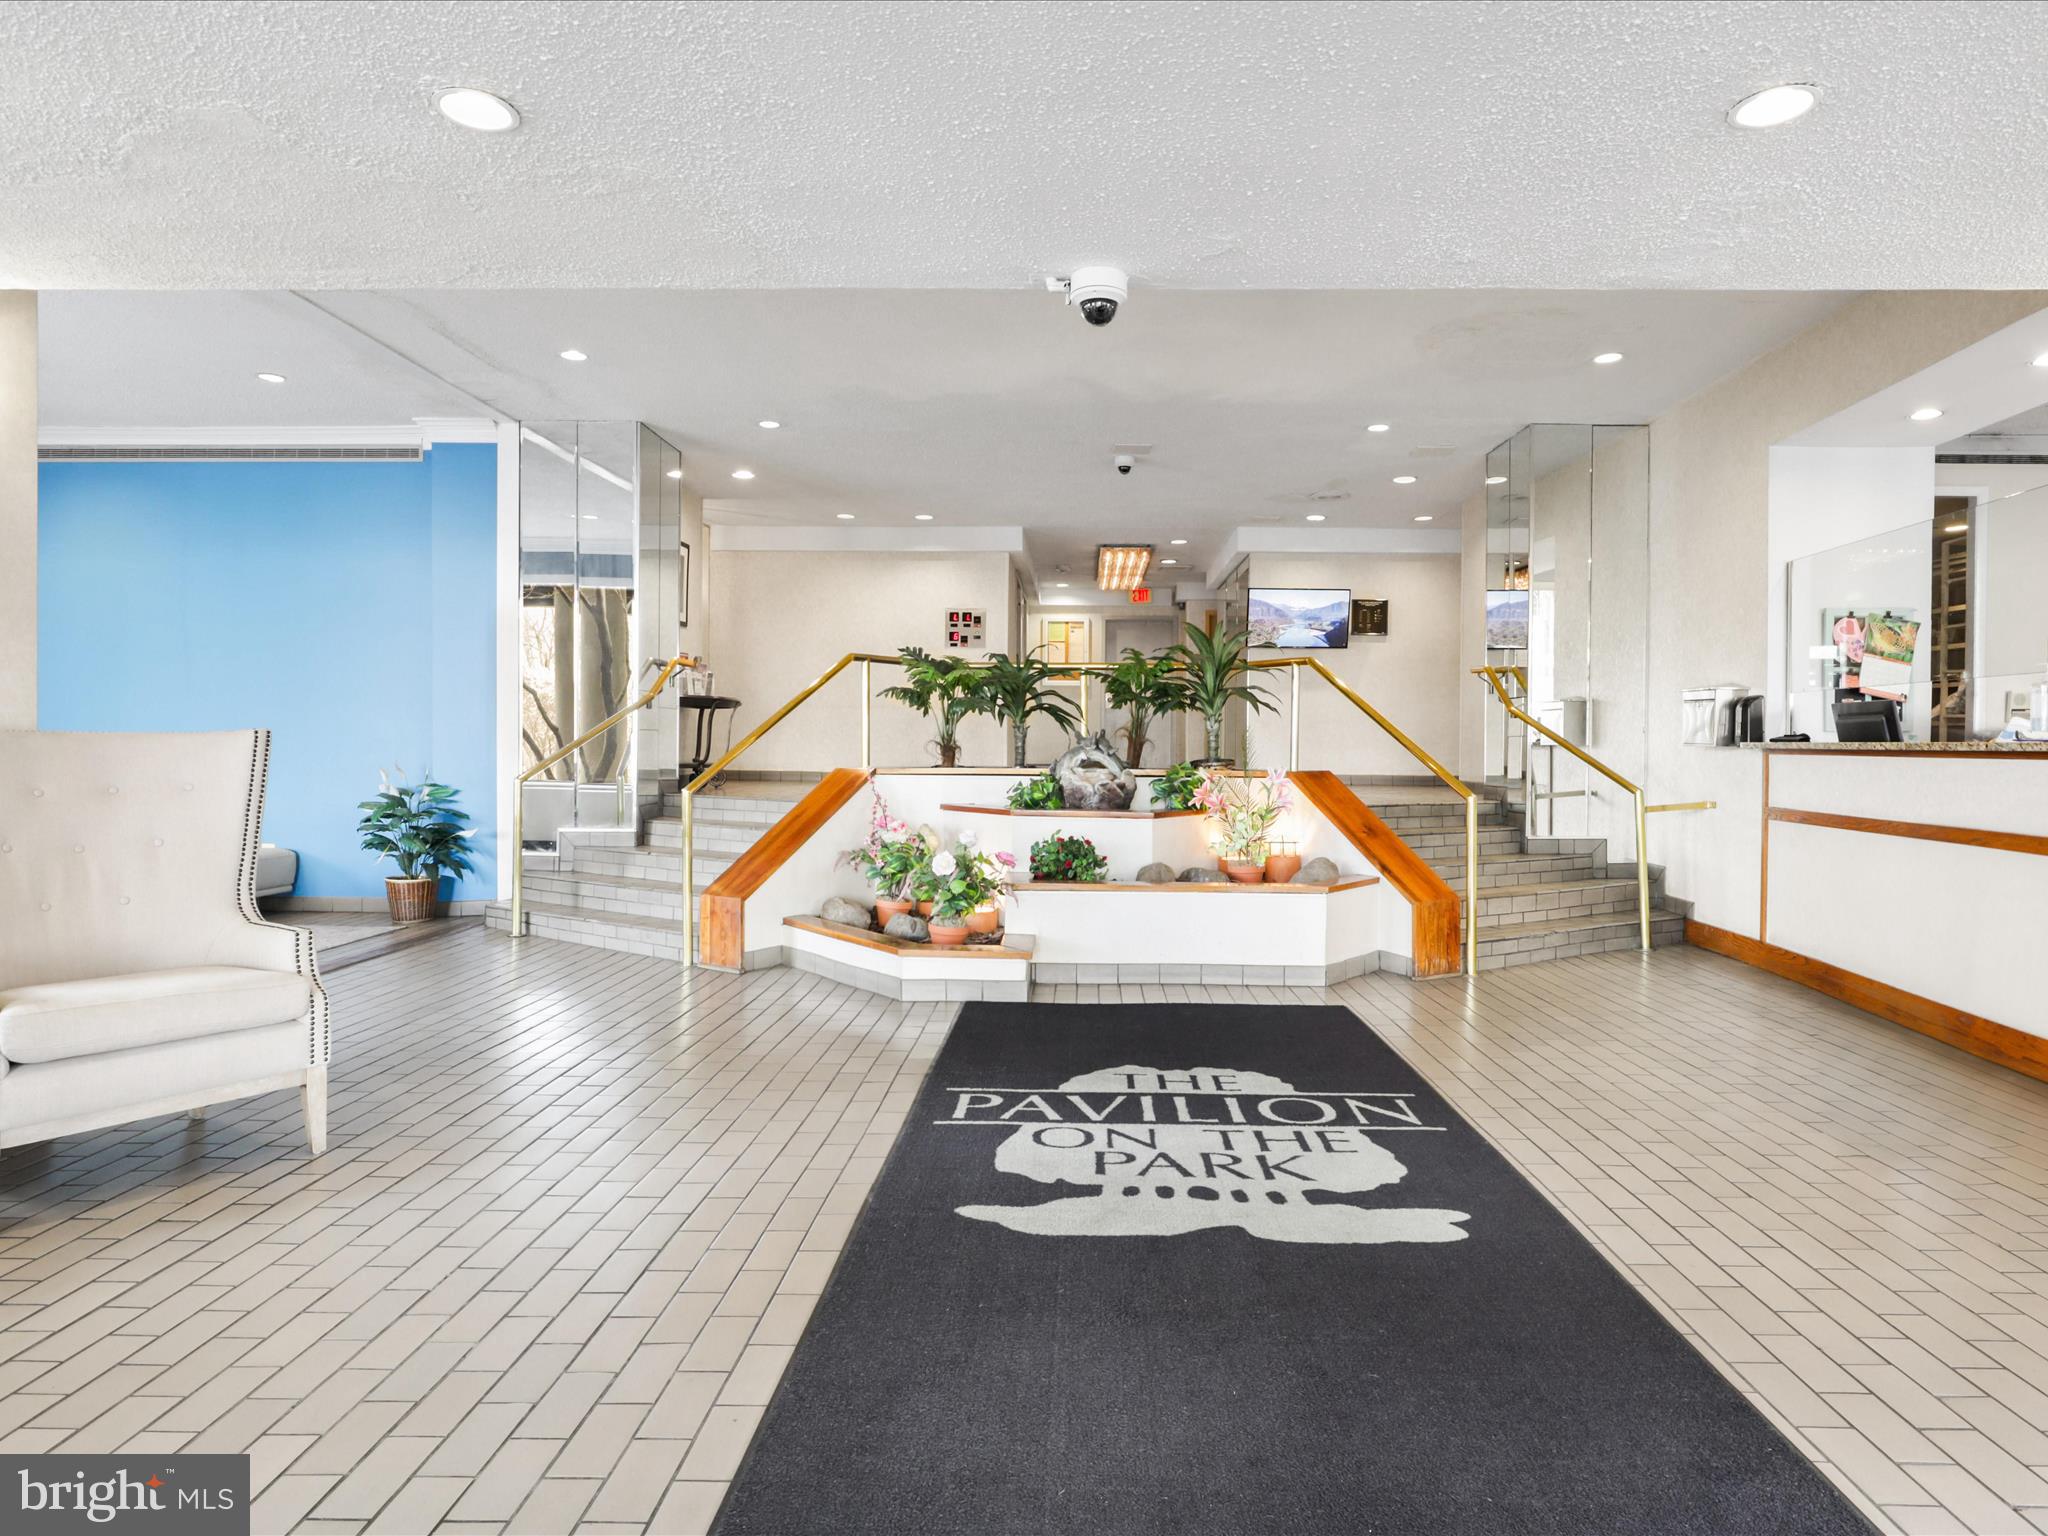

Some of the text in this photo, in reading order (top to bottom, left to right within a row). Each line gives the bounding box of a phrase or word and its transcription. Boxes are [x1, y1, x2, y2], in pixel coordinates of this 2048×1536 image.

[1132, 589, 1149, 602] EXIT
[1113, 1072, 1241, 1091] THE
[951, 1093, 1422, 1125] PAVILION
[1032, 1126, 1359, 1154] ON THE
[1093, 1150, 1317, 1182] PARK
